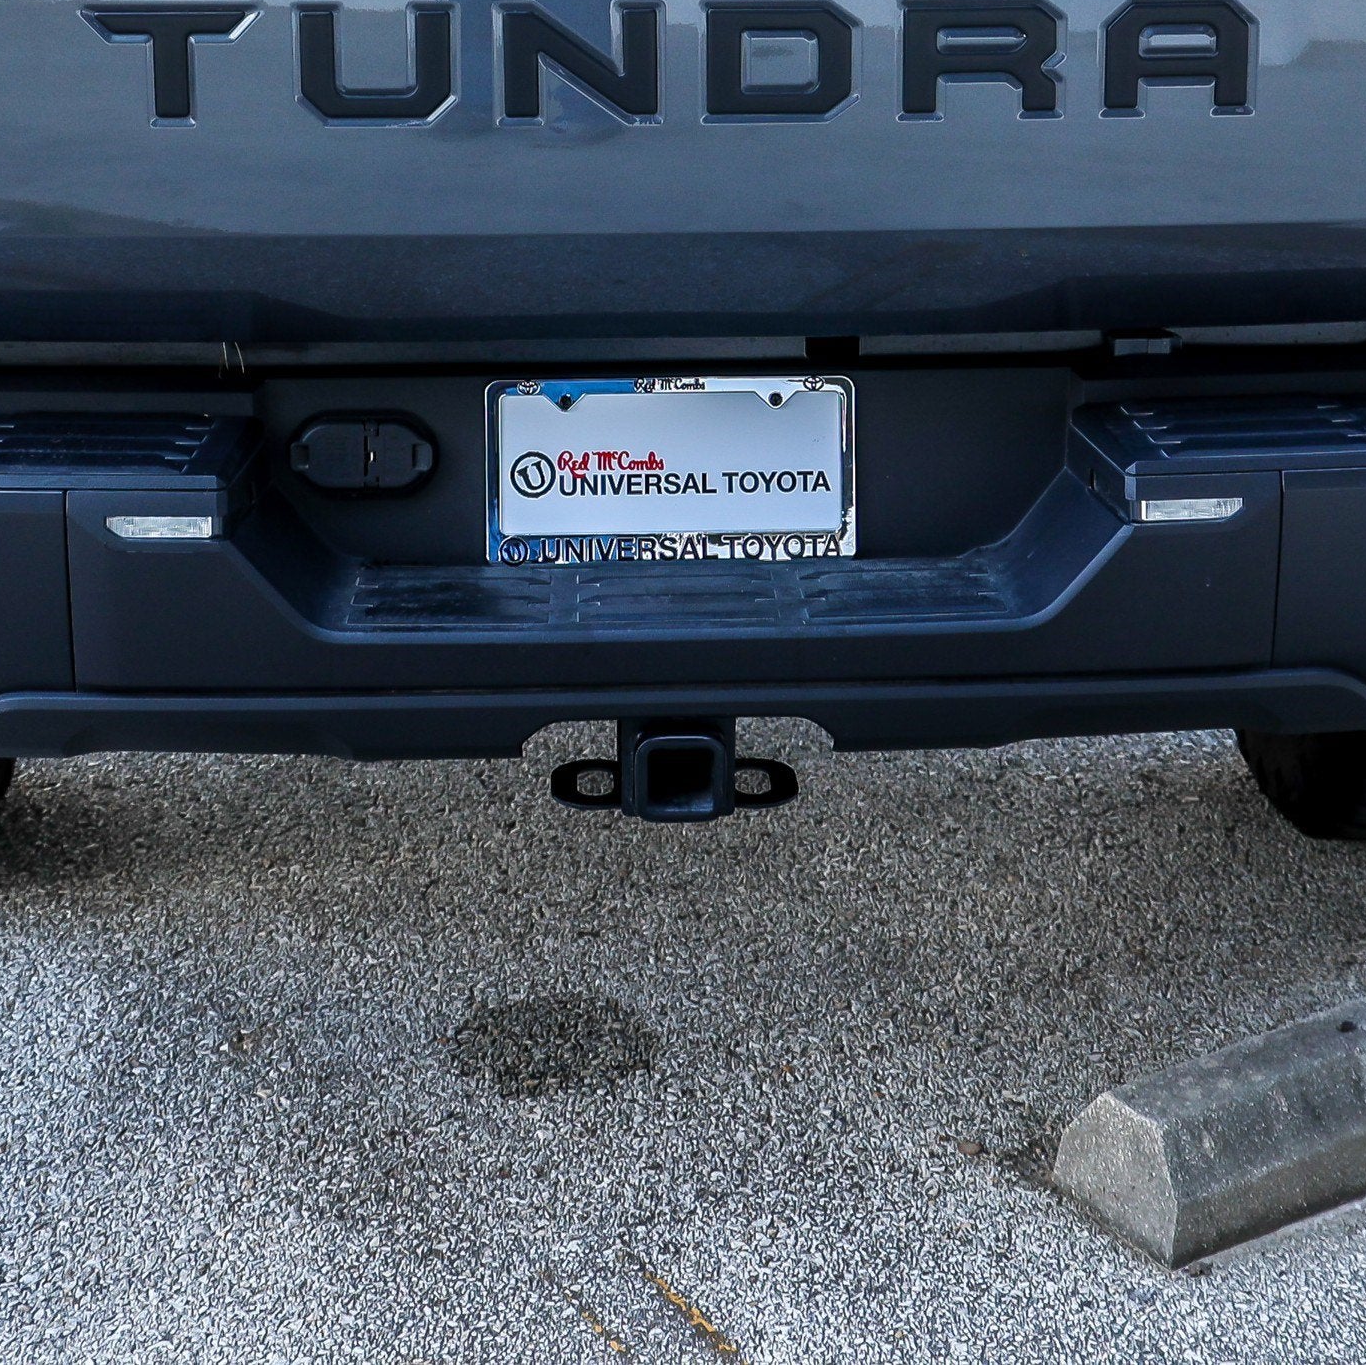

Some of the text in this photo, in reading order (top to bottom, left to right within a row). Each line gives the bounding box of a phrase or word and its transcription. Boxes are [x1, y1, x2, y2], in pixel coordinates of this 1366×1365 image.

[634, 377, 656, 393] Red
[557, 450, 665, 479] Red McCombs
[558, 470, 832, 496] UNIVERSAL TOYOTA
[538, 533, 843, 563] UNIVERSAL TOYOTA
